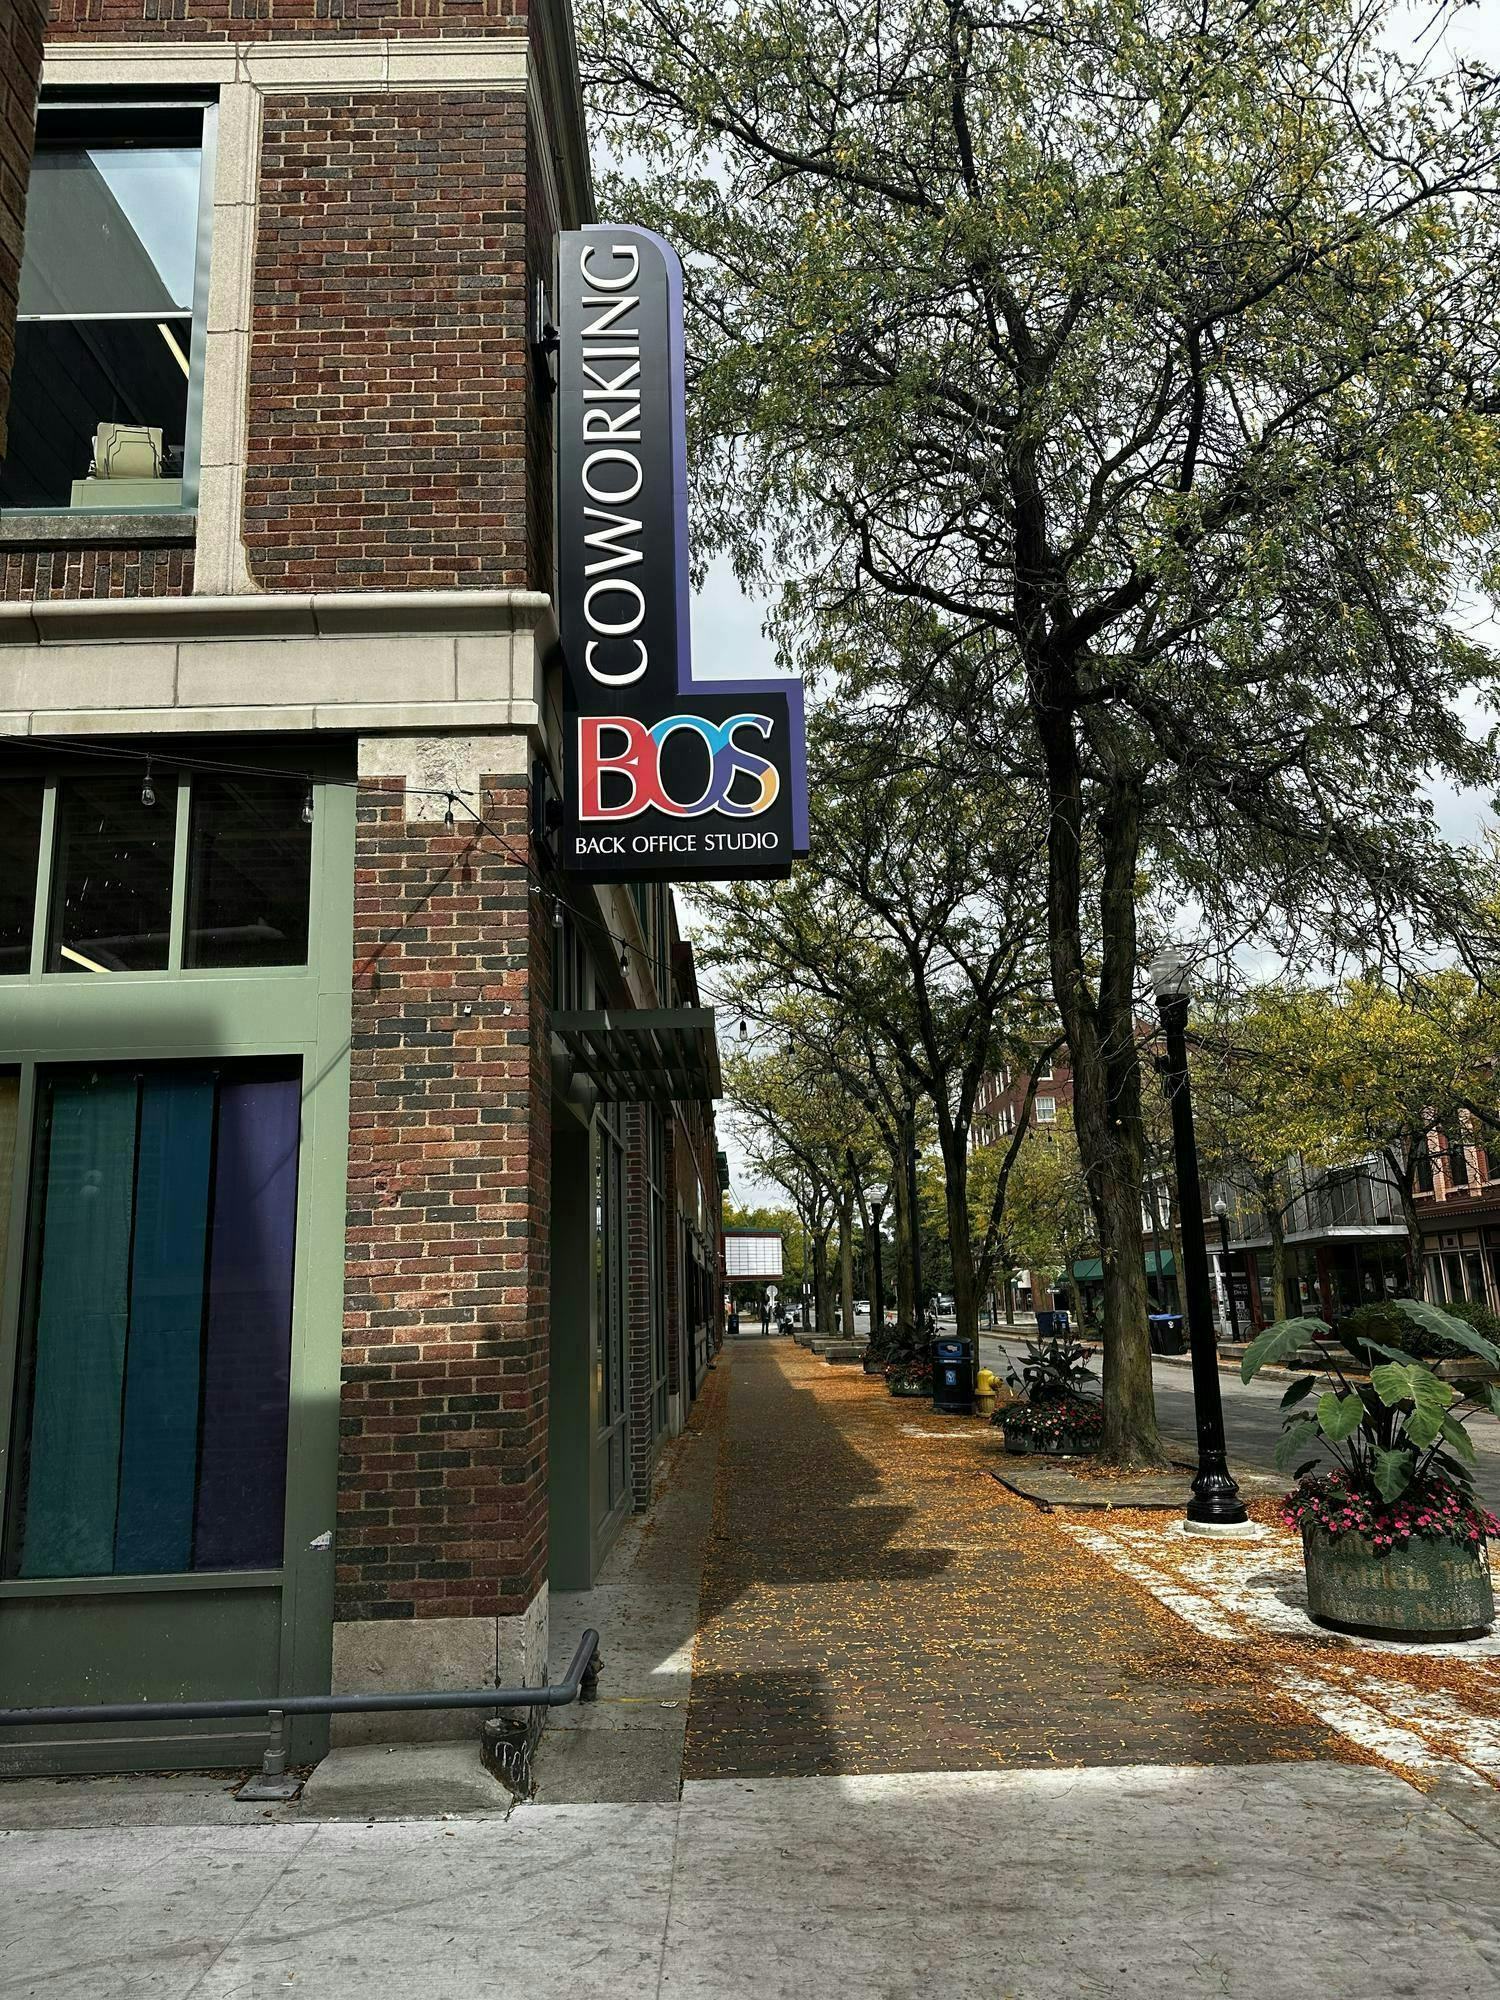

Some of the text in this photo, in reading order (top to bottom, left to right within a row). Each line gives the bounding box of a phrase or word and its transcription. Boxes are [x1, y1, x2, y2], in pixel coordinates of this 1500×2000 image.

[579, 243, 649, 687] COWORKING
[578, 713, 781, 821] BOS
[575, 832, 779, 854] BACK OFFICE STUDIO
